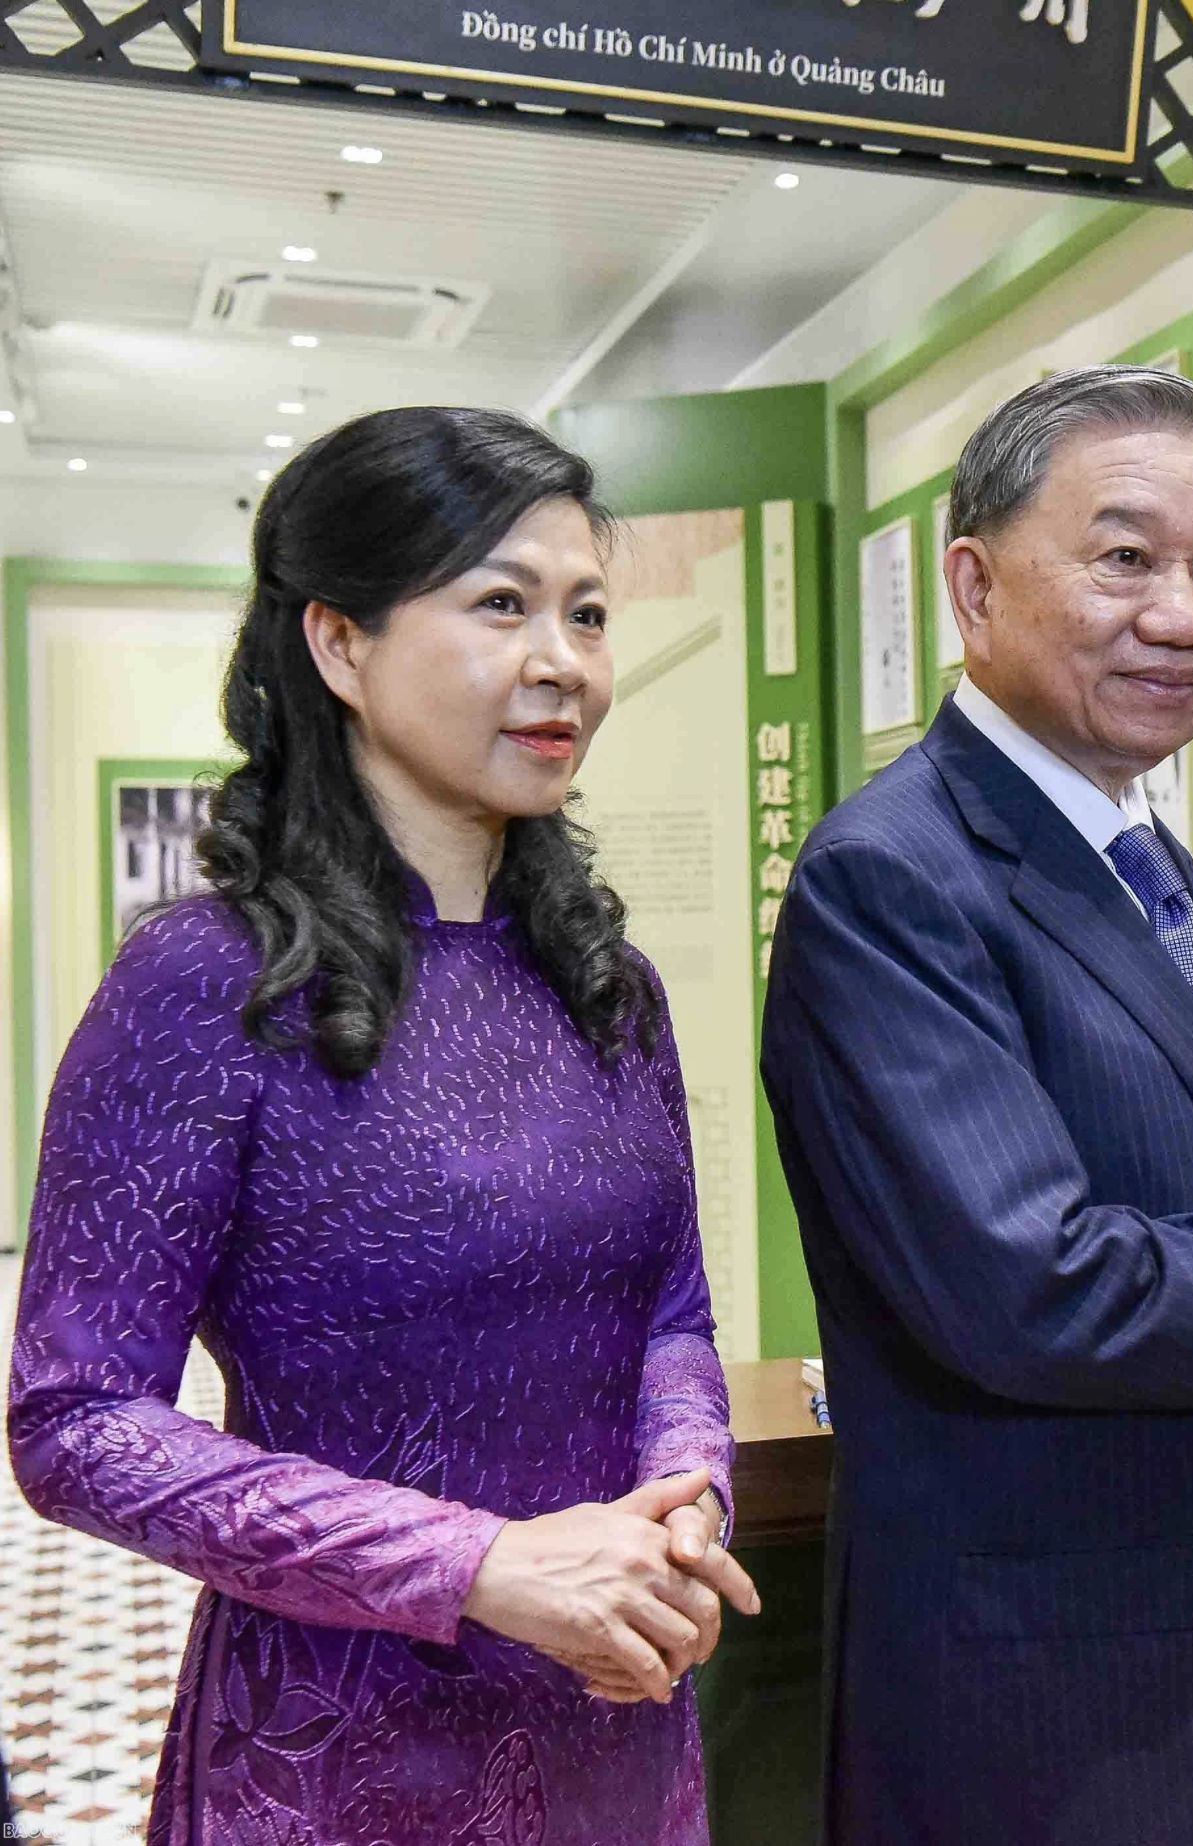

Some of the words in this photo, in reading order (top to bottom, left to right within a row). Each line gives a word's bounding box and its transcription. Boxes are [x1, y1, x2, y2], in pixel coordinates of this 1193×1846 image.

[461, 9, 537, 51] Đồng
[543, 22, 589, 51] chí
[594, 27, 633, 57] Hồ
[639, 35, 688, 64] Chí
[691, 41, 762, 74] Minh
[768, 49, 786, 76] ở
[791, 54, 875, 94] Quảng
[880, 67, 945, 97] Châu
[756, 721, 793, 979] 创建革命
